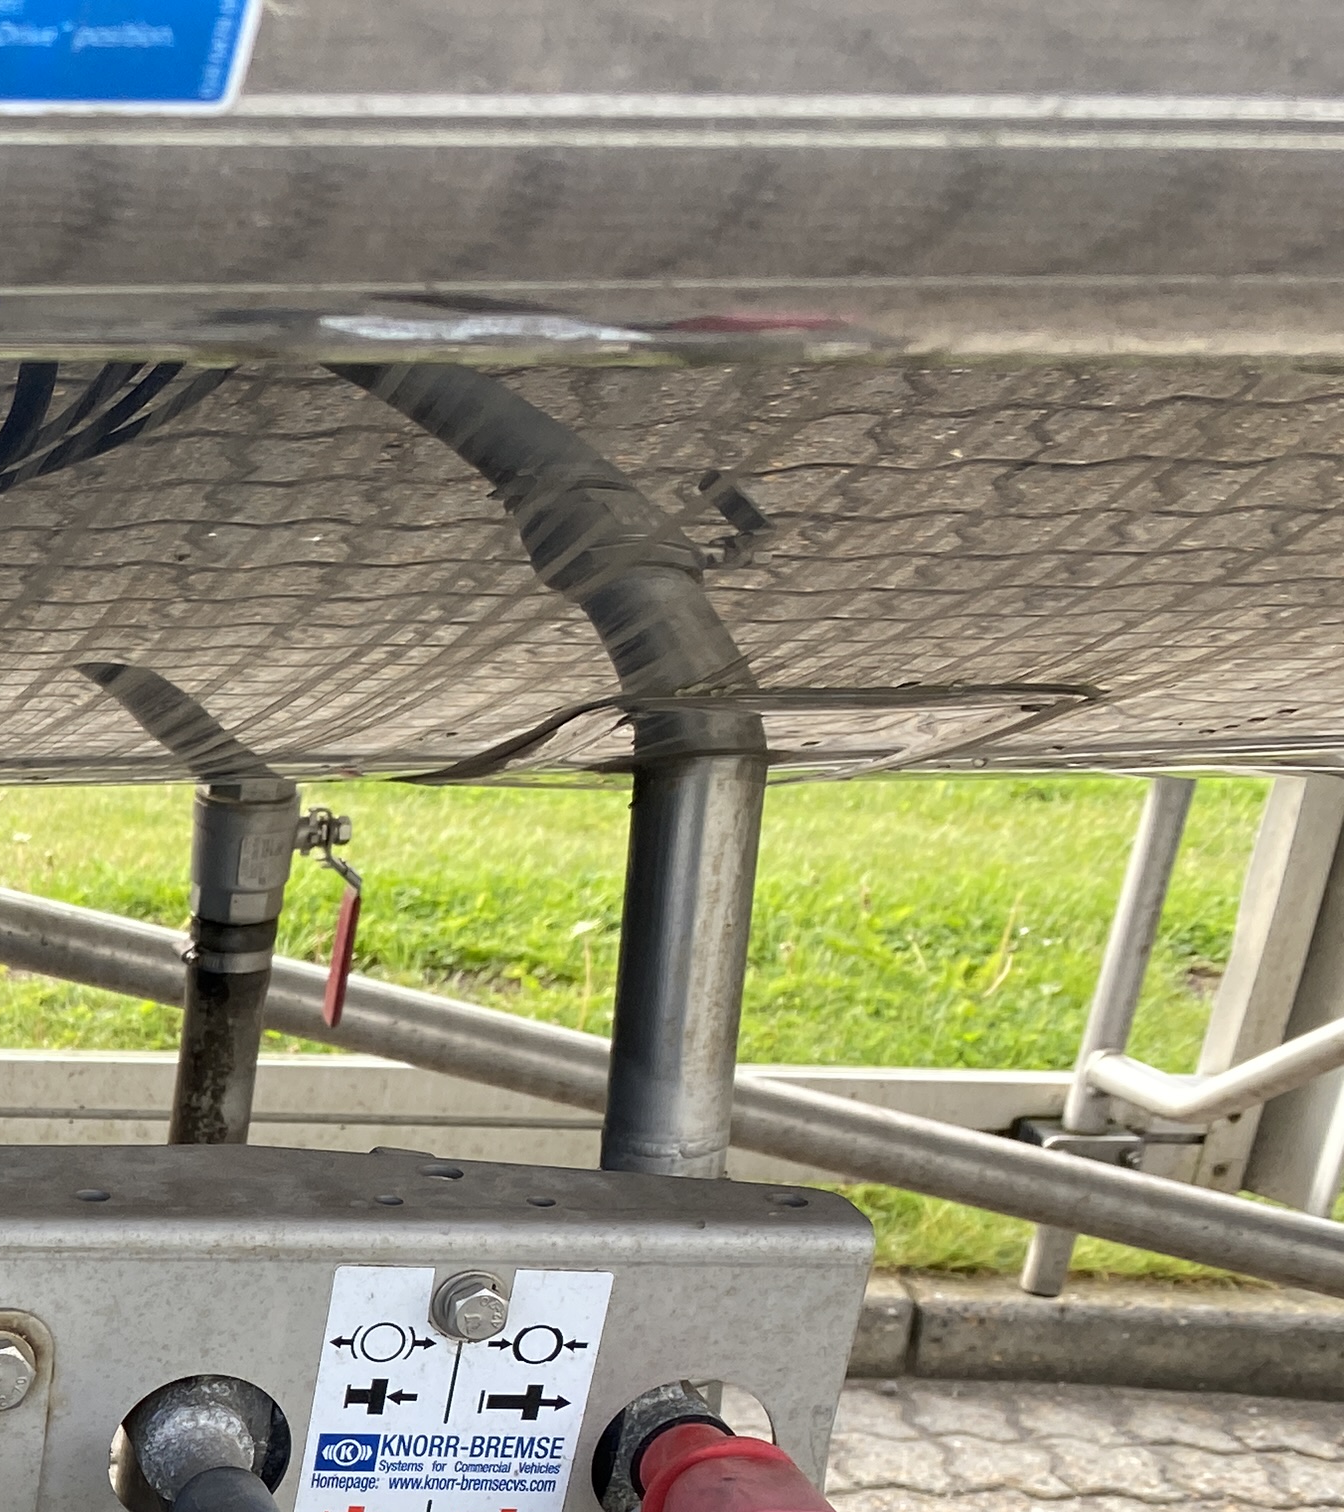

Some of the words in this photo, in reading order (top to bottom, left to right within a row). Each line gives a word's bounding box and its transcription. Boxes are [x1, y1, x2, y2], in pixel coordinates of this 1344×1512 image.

[381, 1435, 565, 1459] KNORR-BREMSE
[378, 1460, 424, 1473] Systems
[431, 1461, 447, 1472] for
[454, 1461, 511, 1473] Commercial
[518, 1463, 562, 1474] Vehicles
[311, 1473, 380, 1492] Homepage:
[388, 1476, 557, 1492] www.knorr-bremsecvs.com
